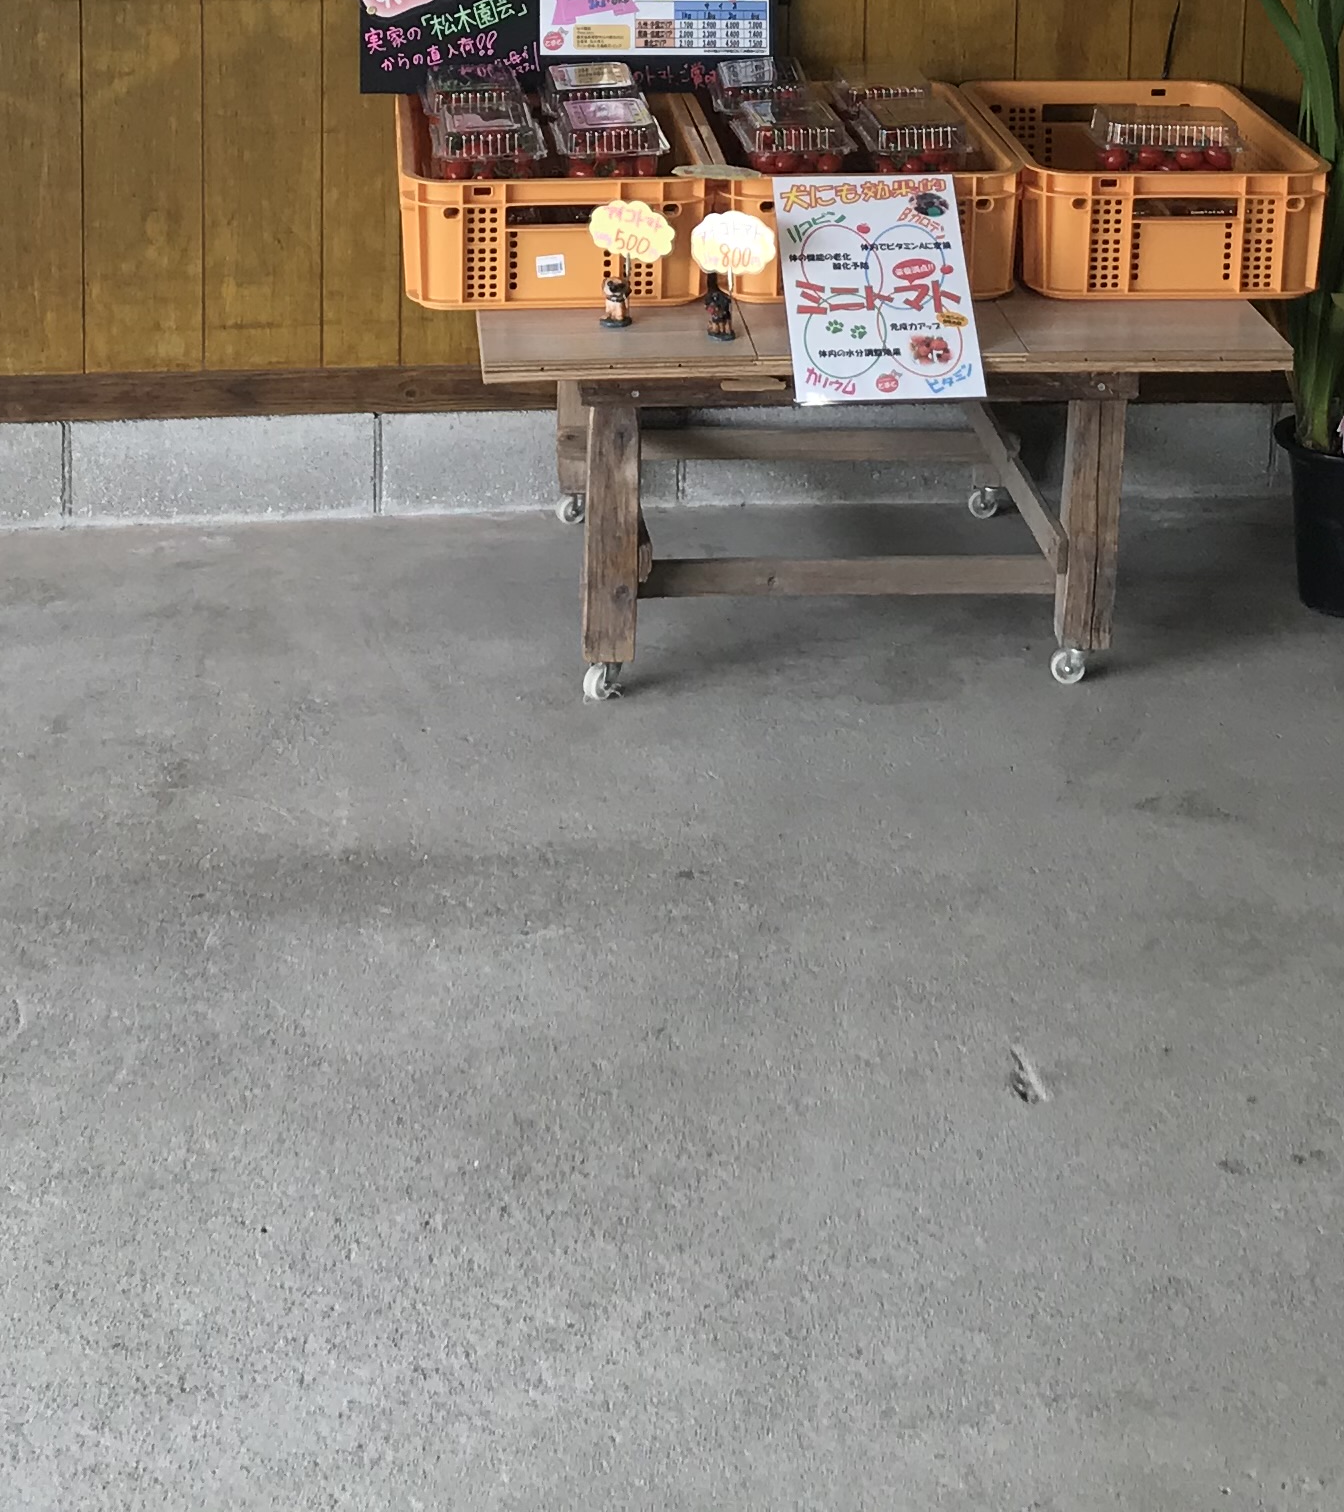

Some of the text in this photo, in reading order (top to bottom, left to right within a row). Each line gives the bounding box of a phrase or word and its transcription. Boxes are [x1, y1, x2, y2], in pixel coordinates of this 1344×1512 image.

[780, 177, 947, 214] 犬にも効果的
[786, 210, 847, 243] リコピン
[794, 278, 963, 317] ミニトマト
[804, 366, 858, 397] カリウム
[925, 362, 974, 394] ビタミン
